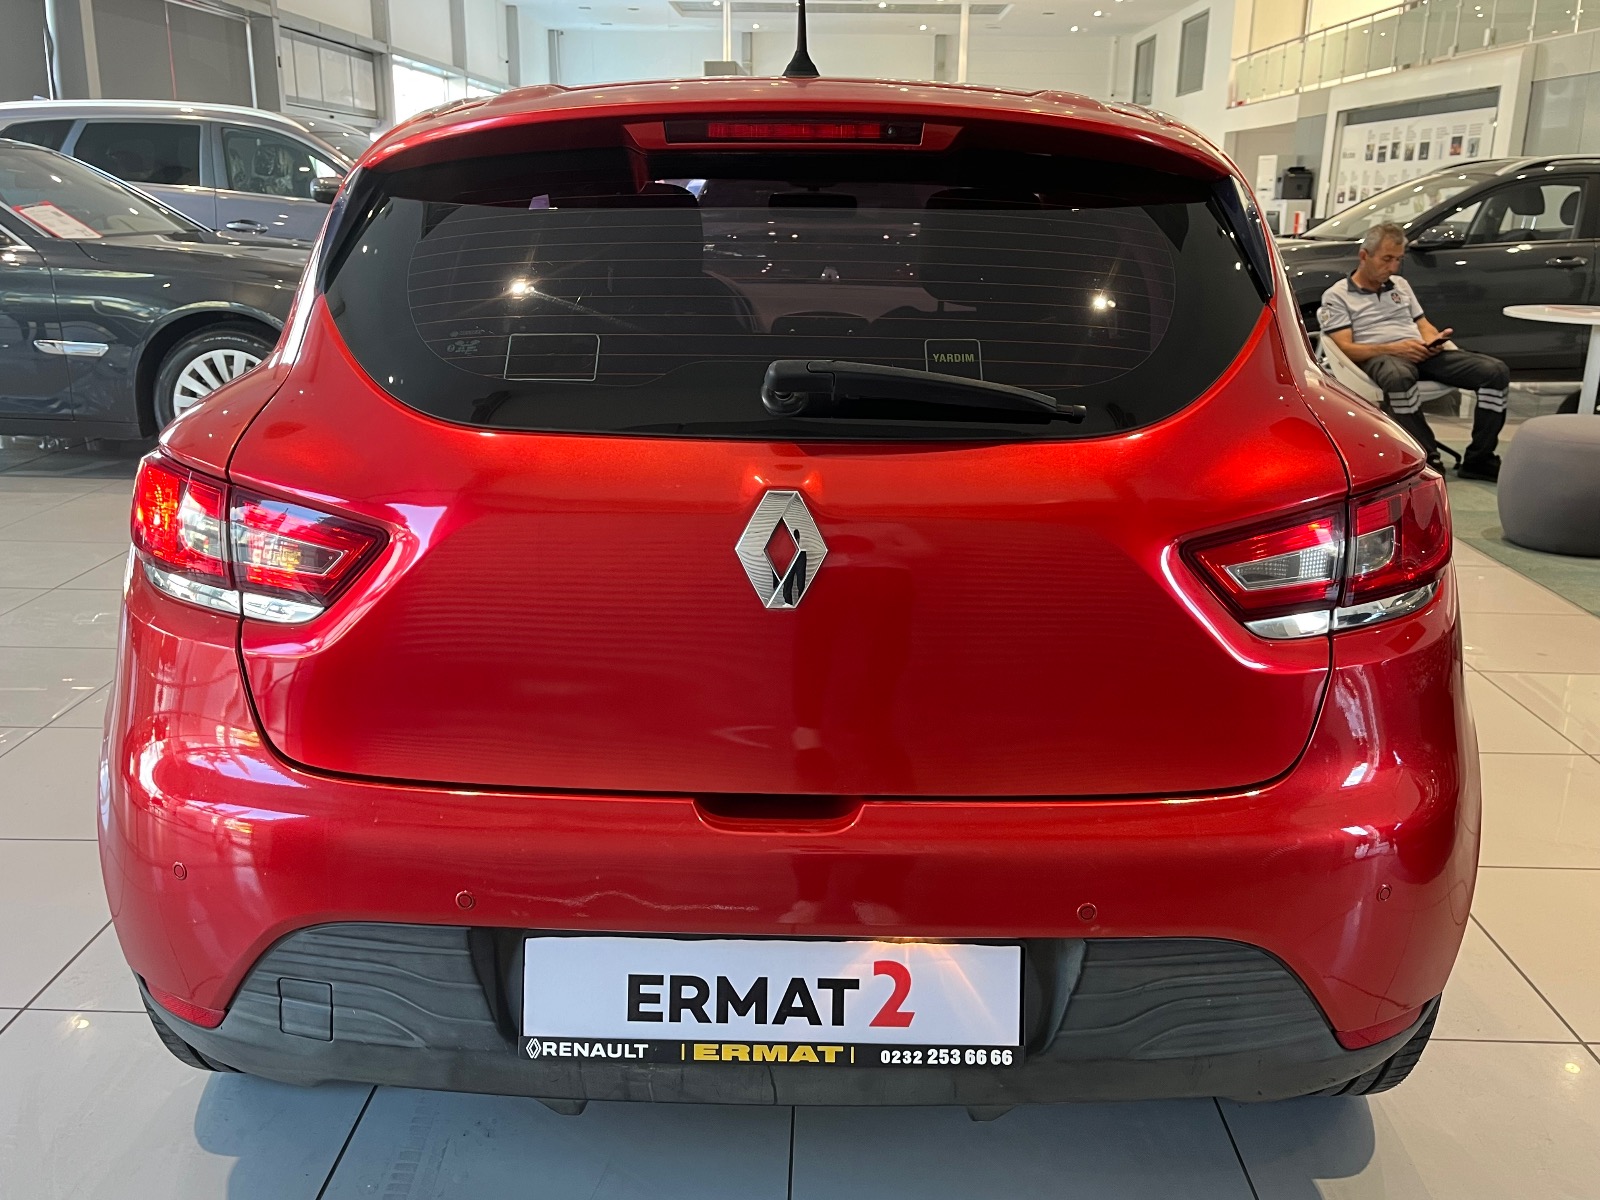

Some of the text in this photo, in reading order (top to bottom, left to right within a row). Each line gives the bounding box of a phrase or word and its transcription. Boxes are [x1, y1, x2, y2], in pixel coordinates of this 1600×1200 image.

[932, 353, 975, 363] YARDIM
[626, 959, 916, 1028] ERMAT 2
[541, 1041, 1013, 1066] RENAULT ERMAT 0232 253 66 66
